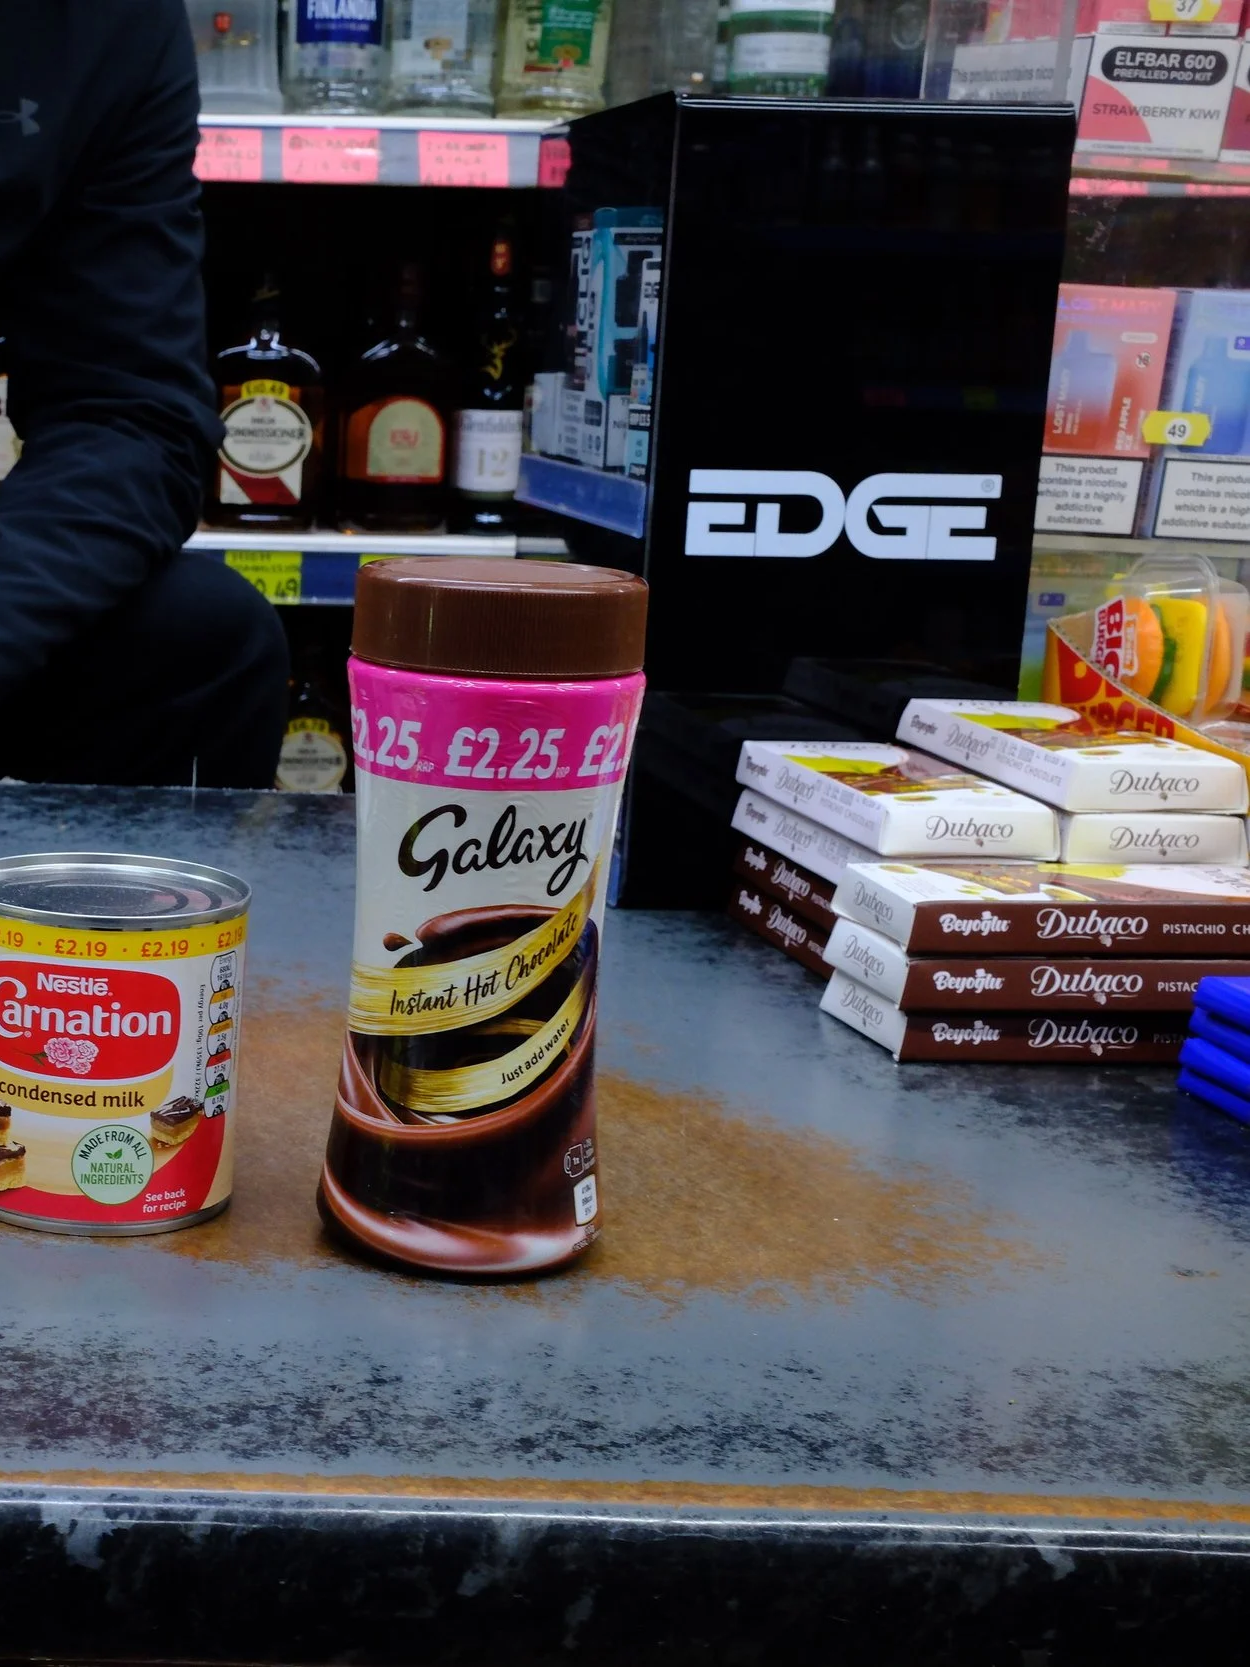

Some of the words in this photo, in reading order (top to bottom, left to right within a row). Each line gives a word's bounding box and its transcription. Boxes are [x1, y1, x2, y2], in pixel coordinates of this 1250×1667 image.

[1115, 51, 1180, 69] ELFBAR
[1184, 54, 1216, 70] 600
[1114, 68, 1167, 80] PREFILLED
[1092, 103, 1185, 119] STRAWBERRY
[1189, 106, 1220, 120] KIWI
[1166, 424, 1187, 438] 49
[1055, 462, 1075, 473] This
[1078, 464, 1118, 476] product
[1191, 472, 1213, 482] This
[1085, 478, 1128, 489] nicotine
[1175, 488, 1221, 498] contains
[685, 469, 1003, 561] EDGE
[1055, 502, 1103, 513] addictive
[1174, 503, 1205, 513] which
[1162, 518, 1209, 528] addictive
[444, 727, 566, 779] £2.25
[1109, 768, 1200, 796] Dubaco
[925, 814, 1014, 842] Dubaco
[1109, 826, 1200, 852] Dubaco
[398, 804, 590, 896] Galaxy
[854, 881, 893, 921] Dubaco
[1036, 907, 1148, 940] Dubaco
[1163, 923, 1226, 935] PISTACHIO
[54, 938, 107, 957] £2.19
[141, 939, 189, 958] £2.19
[845, 934, 885, 977] Dubaco
[390, 983, 458, 1015] Instant
[464, 970, 500, 1006] Hot
[505, 911, 578, 990] Chocolate
[1031, 965, 1144, 998] Dubaco
[1157, 981, 1199, 993] PISTAC
[842, 983, 884, 1025] Dubaco
[1028, 1019, 1139, 1049] Dubaco
[501, 1064, 524, 1085] Just
[525, 1050, 545, 1070] add
[544, 1018, 570, 1050] water
[0, 1080, 97, 1107] condensed
[102, 1091, 145, 1108] milk
[79, 1134, 104, 1160] MADE
[104, 1131, 135, 1146] FROM
[132, 1141, 148, 1160] ALL
[80, 1173, 144, 1185] INGREDIENTS
[91, 1162, 135, 1174] NATURAL
[142, 1204, 158, 1214] for
[160, 1200, 187, 1211] recipe
[145, 1192, 163, 1203] See
[164, 1188, 186, 1200] back
